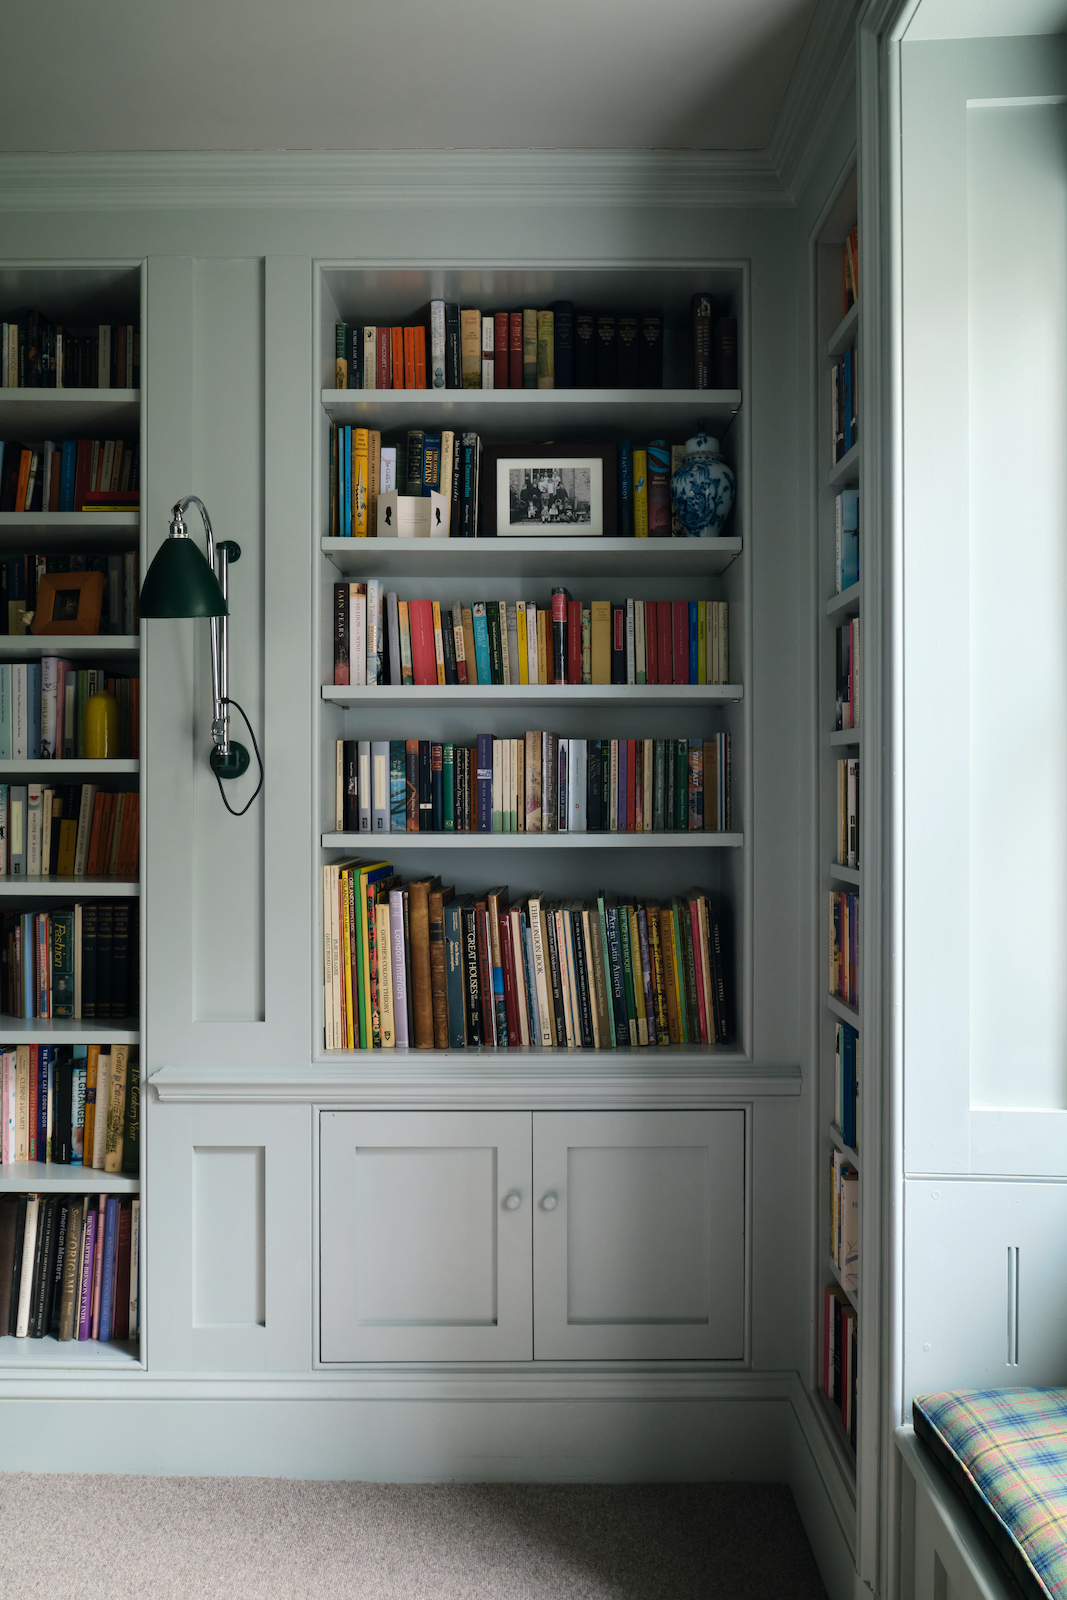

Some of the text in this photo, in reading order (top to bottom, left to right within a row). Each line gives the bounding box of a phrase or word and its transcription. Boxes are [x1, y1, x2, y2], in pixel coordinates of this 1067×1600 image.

[368, 626, 376, 653] BROOKLYN
[54, 922, 66, 968] Fashion
[532, 922, 541, 953] LONDON
[394, 930, 404, 1000] London Interiors
[467, 932, 478, 995] GREAT HOUSES
[535, 954, 544, 976] BOOK
[608, 915, 622, 998] Art in Latin America
[666, 955, 674, 986] BEARDSLEY
[116, 1052, 125, 1074] Guide
[77, 1082, 86, 1129] GRANGER
[114, 1084, 122, 1114] Creative
[128, 1086, 139, 1120] Cookery
[130, 1122, 138, 1142] Year
[70, 1208, 79, 1234] Secrets
[55, 1207, 68, 1282] American Masters.
[64, 1241, 78, 1294] ORIGAMI
[82, 1296, 87, 1304] IN
